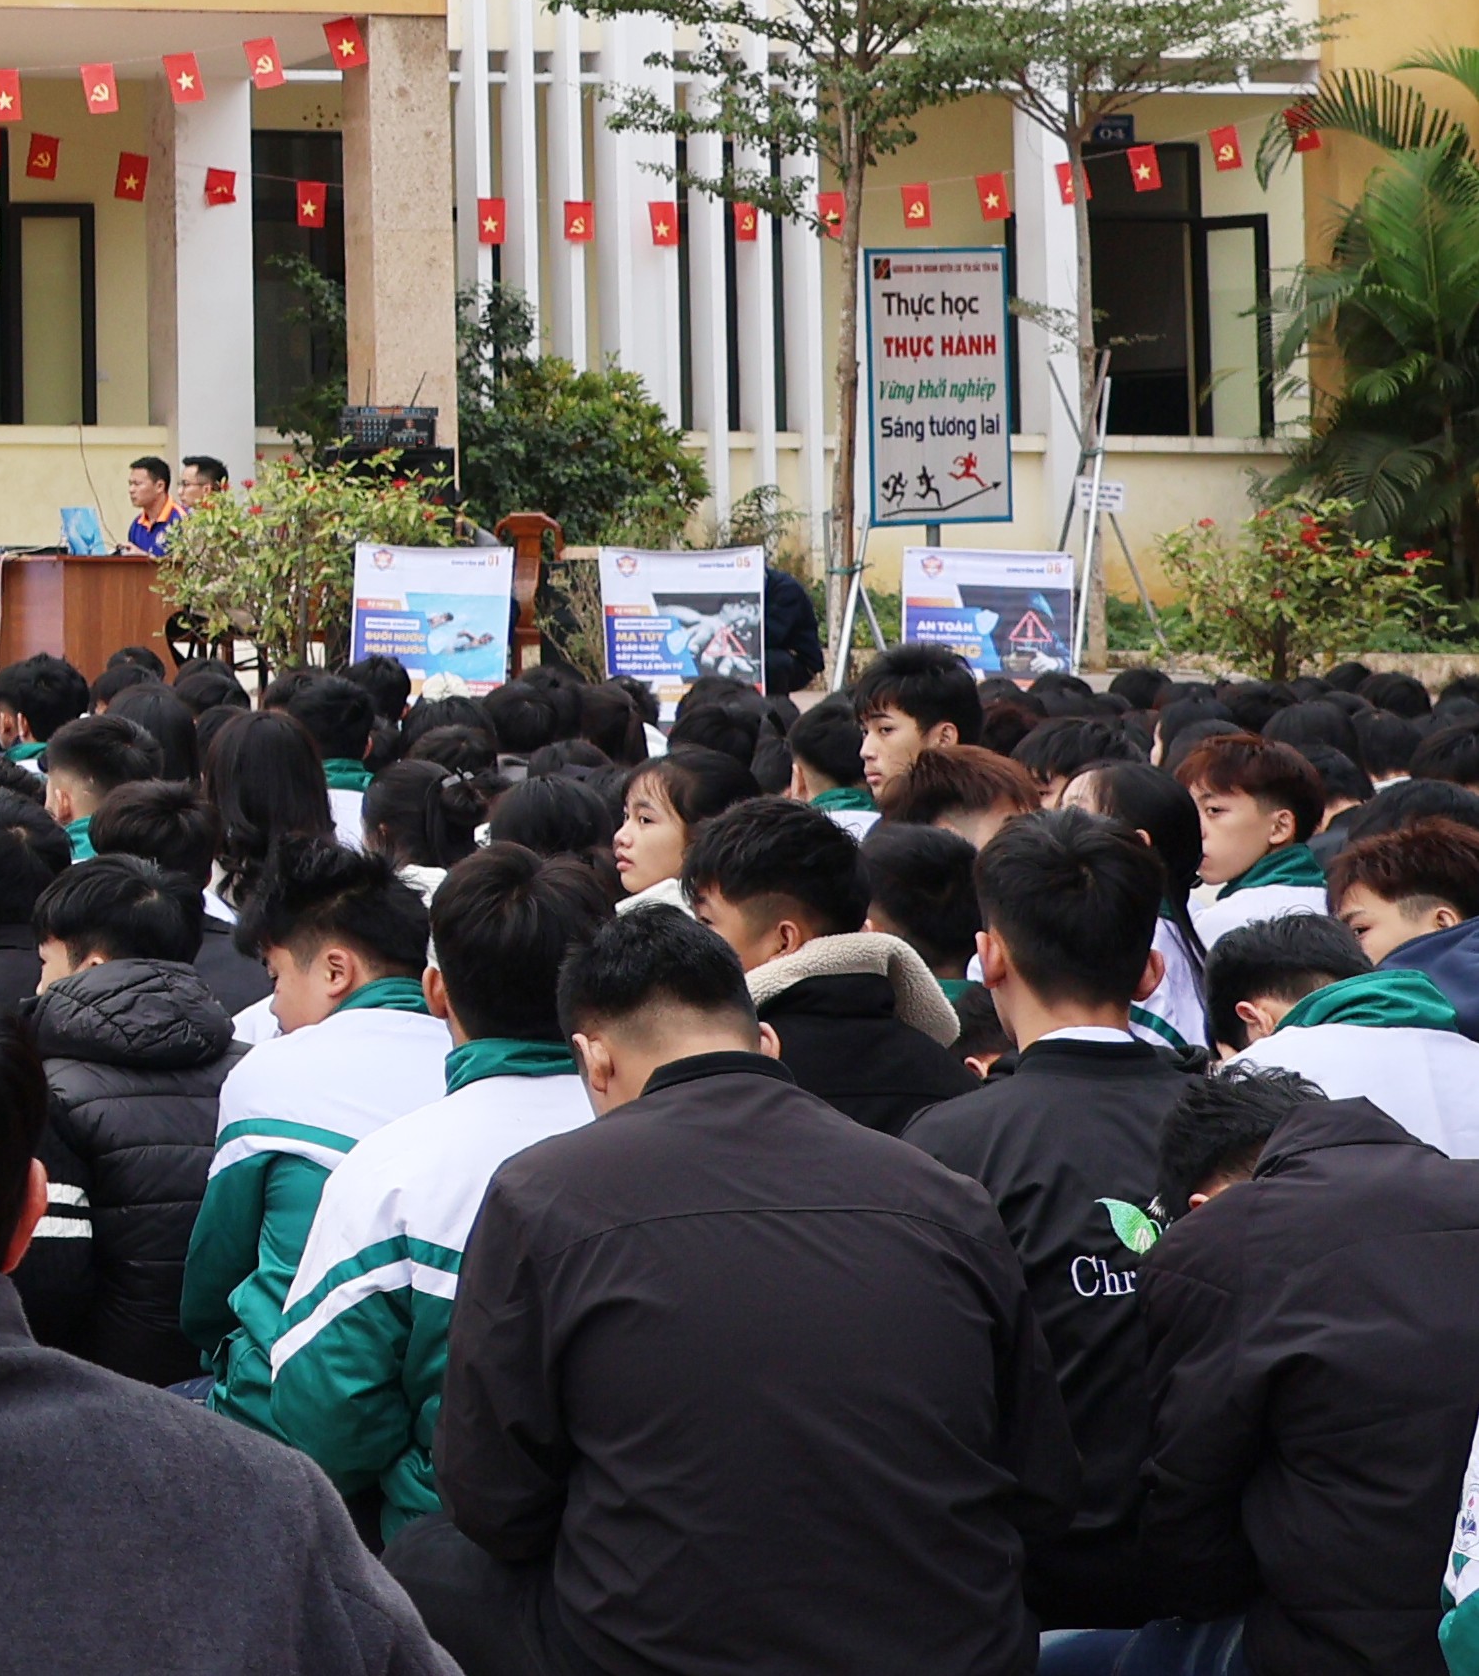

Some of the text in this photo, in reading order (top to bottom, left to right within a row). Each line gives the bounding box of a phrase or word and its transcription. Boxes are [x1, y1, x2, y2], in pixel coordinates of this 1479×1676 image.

[882, 292, 979, 323] Thực học
[883, 329, 996, 363] THỰC HÀNH
[879, 377, 997, 404] Vững khởi nghiệp
[881, 413, 1001, 442] Sáng tương lai
[736, 556, 750, 568] 05
[616, 632, 637, 642] MA
[917, 618, 974, 632] AN TOÀN
[1070, 1255, 1138, 1298] Chr
